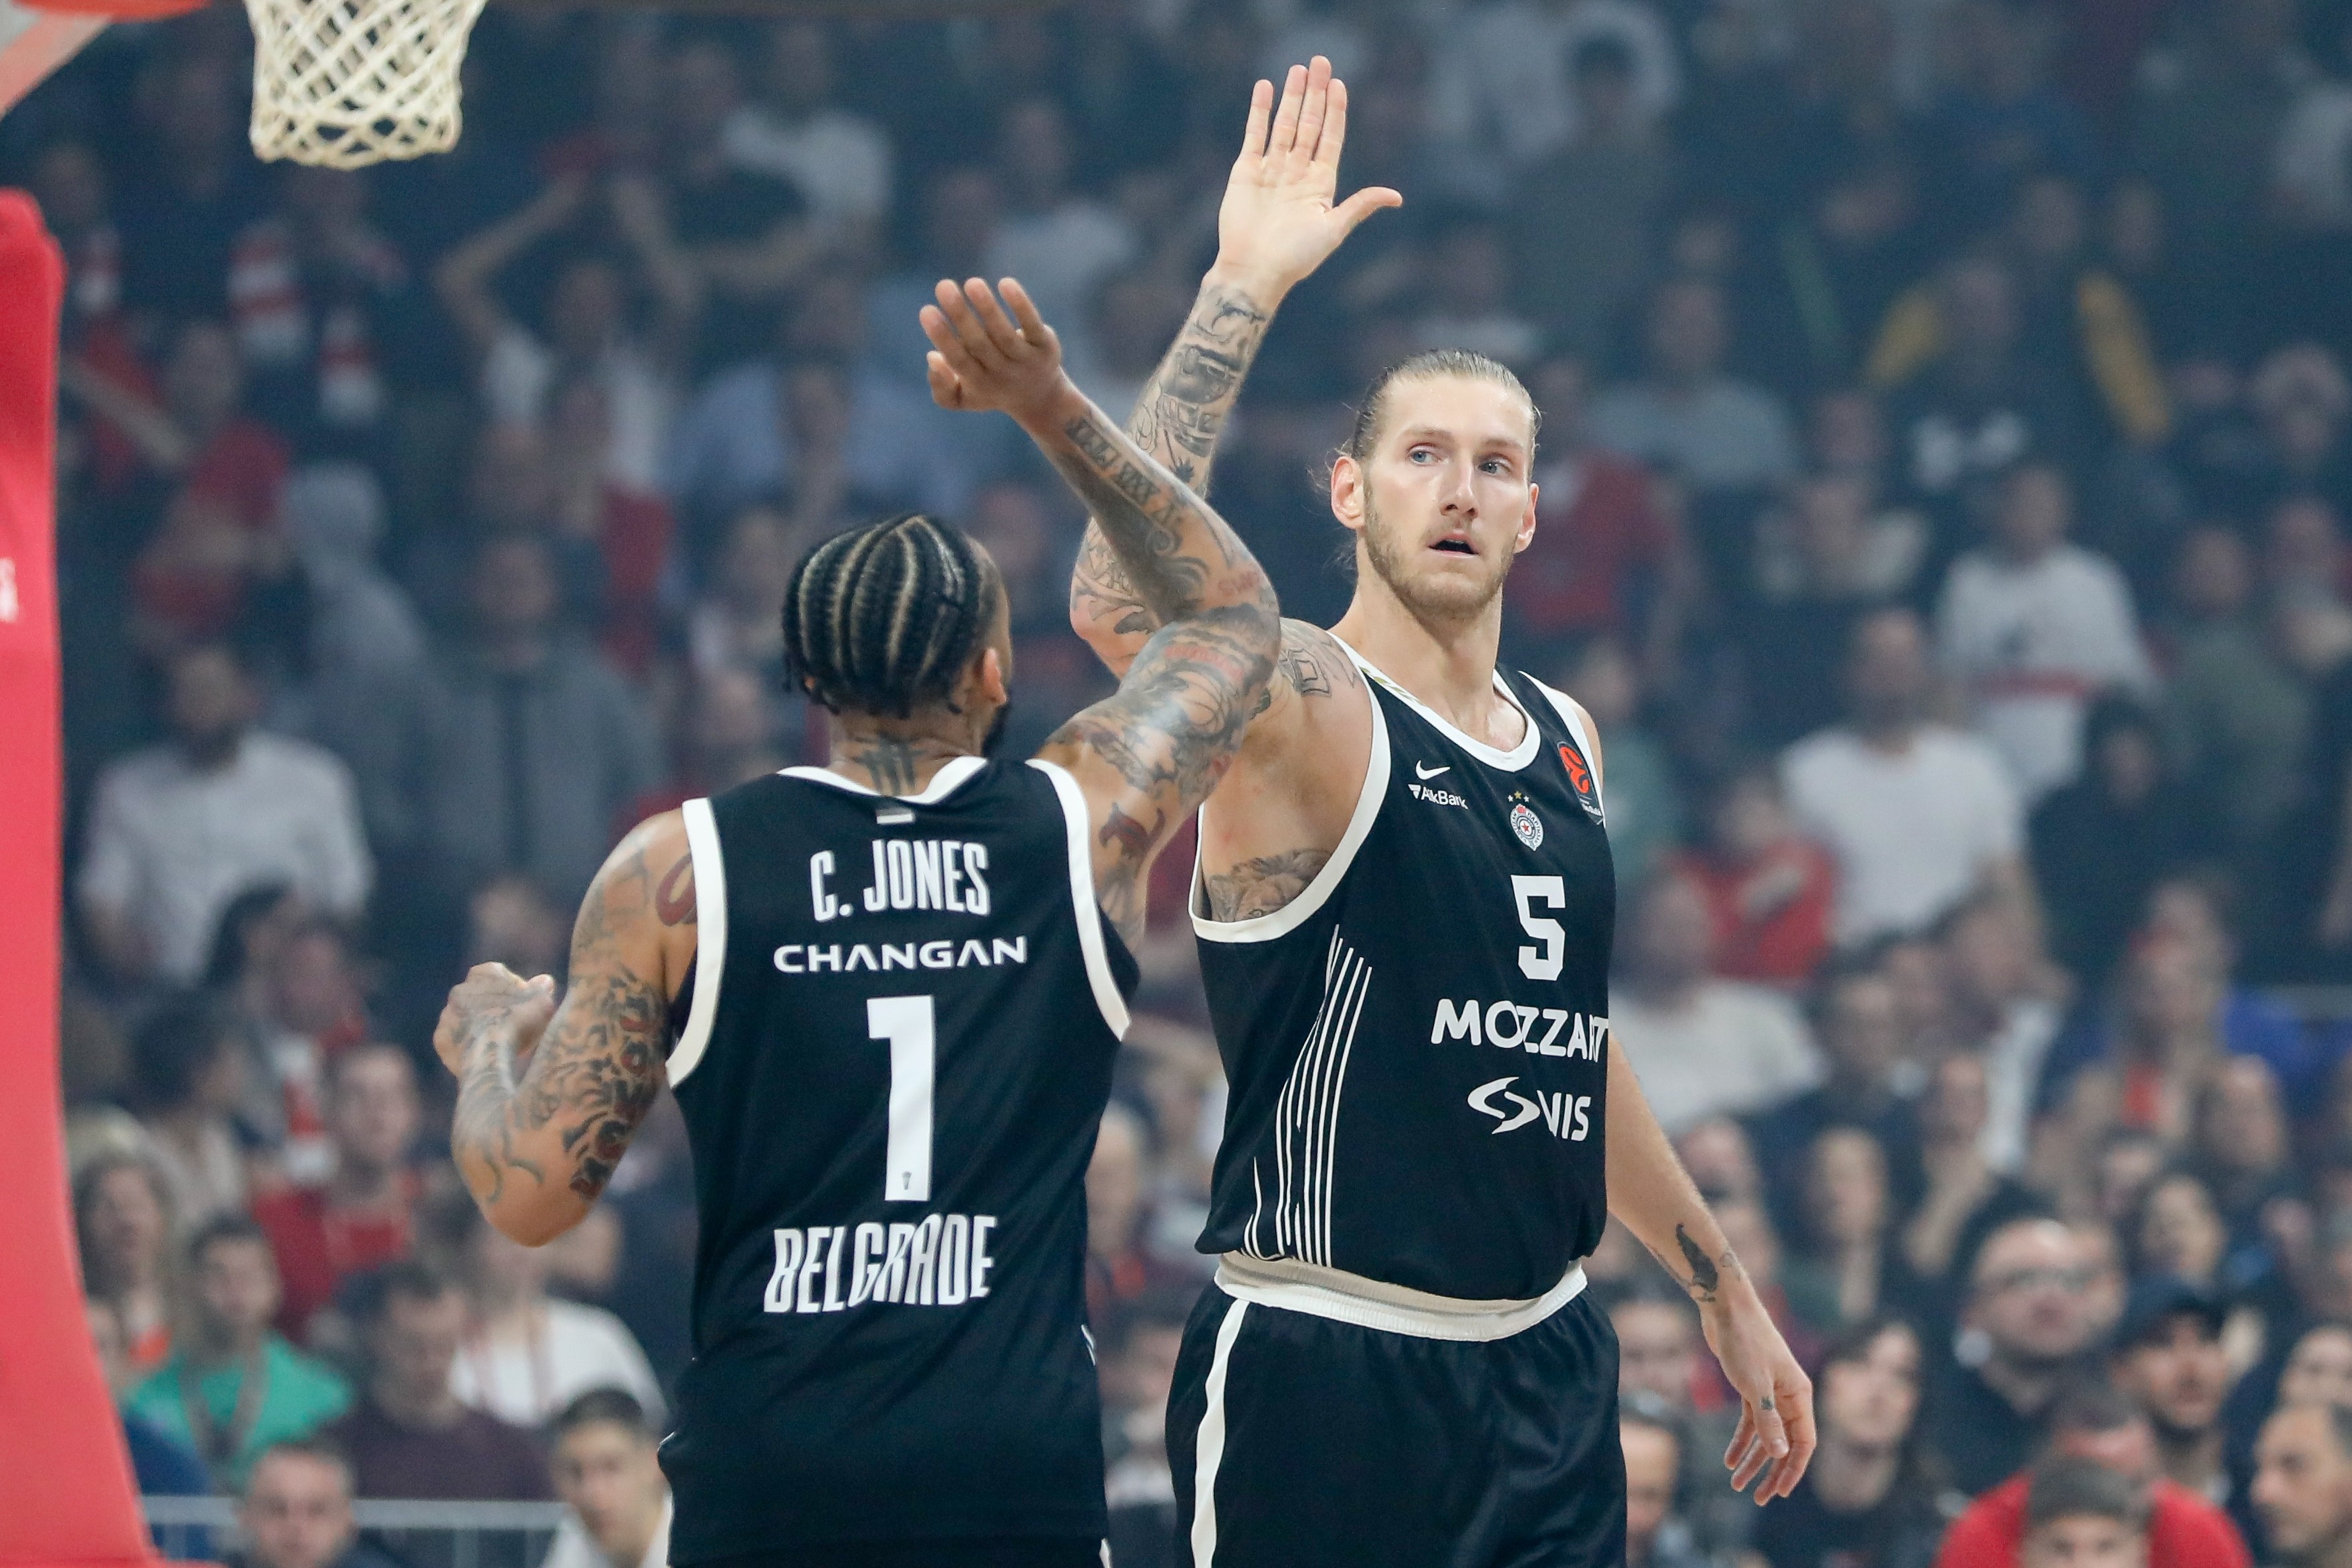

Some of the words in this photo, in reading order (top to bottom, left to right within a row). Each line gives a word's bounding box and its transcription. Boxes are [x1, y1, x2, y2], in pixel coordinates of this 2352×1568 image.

[810, 849, 853, 923] C.
[863, 839, 991, 917] JONES
[1511, 875, 1565, 981] 5
[773, 935, 1027, 973] CHANGAN
[867, 995, 934, 1201] 1
[763, 1213, 997, 1313] BELGRADE
